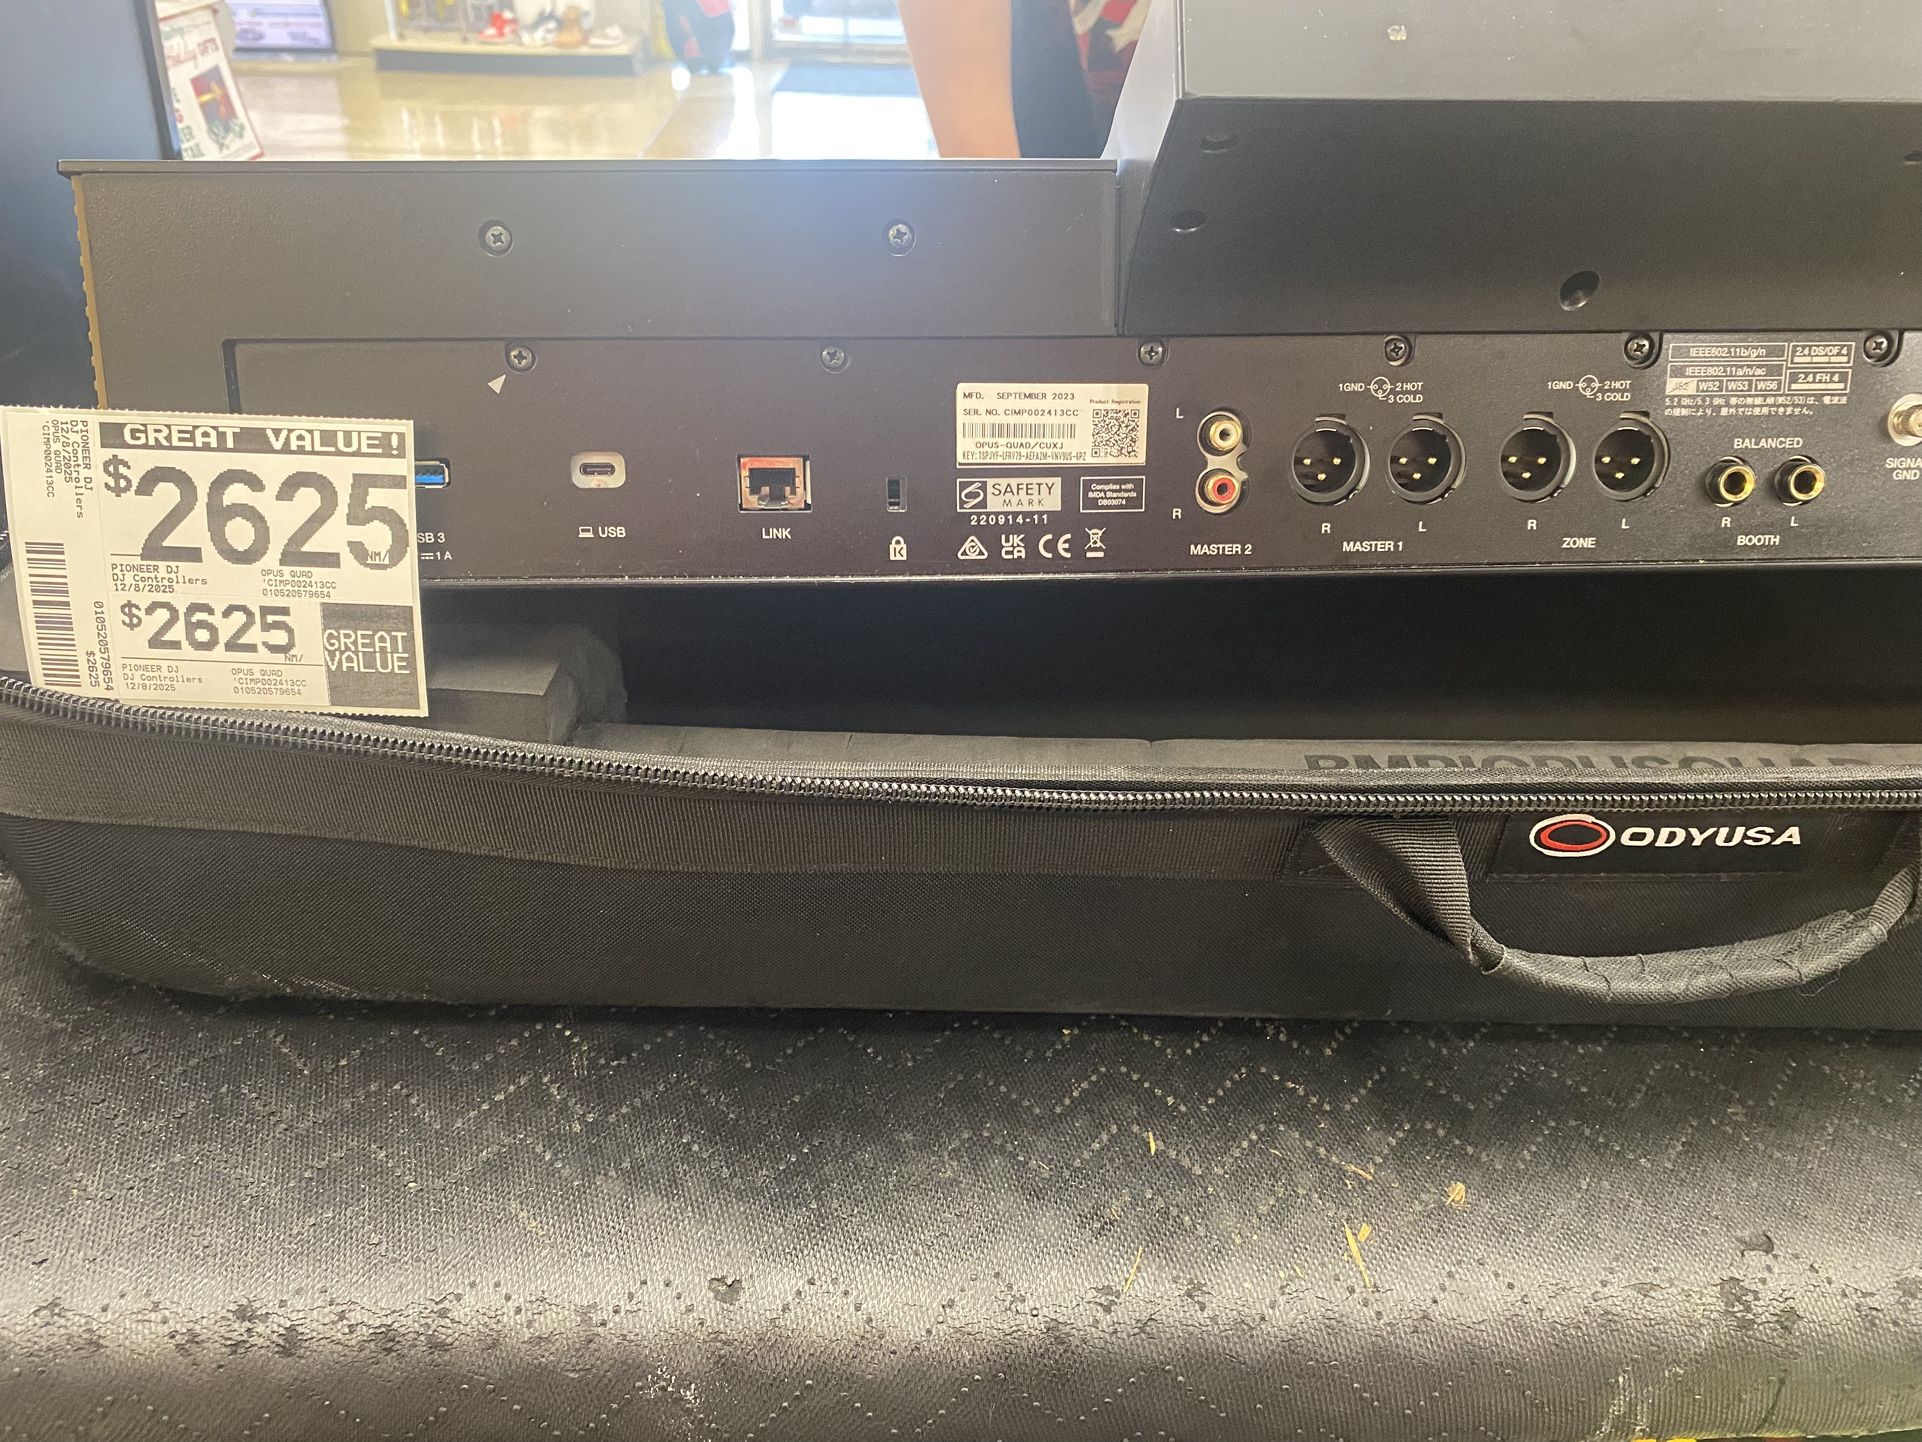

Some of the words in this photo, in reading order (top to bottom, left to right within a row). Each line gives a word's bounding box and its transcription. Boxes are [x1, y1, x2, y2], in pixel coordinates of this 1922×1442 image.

[1689, 347, 1767, 358] IEEE802.11b/g/n
[1795, 347, 1809, 356] 2.4
[1841, 347, 1848, 355] 4
[1685, 366, 1767, 377] IEEE802.11a/n/ac
[1798, 374, 1813, 383] 2.4
[1815, 374, 1831, 382] FH
[1832, 374, 1839, 382] 4
[1403, 383, 1424, 391] HOT
[1611, 381, 1632, 389] HOT
[1698, 381, 1720, 391] W52
[1727, 381, 1749, 391] W53
[1756, 381, 1778, 390] W56
[963, 392, 985, 400] MFD.
[996, 392, 1047, 400] SEPTEMBER
[1052, 392, 1075, 400] 2023
[1388, 394, 1394, 403] 3
[1396, 394, 1424, 403] COLD
[1596, 393, 1602, 401] 3
[1604, 392, 1631, 401] COLD
[963, 409, 982, 417] SER.
[985, 409, 1000, 417] NO.
[1004, 409, 1079, 417] CIMP002413CC
[1175, 407, 1184, 419] L
[51, 419, 61, 444] OPUS
[70, 420, 79, 434] DJ
[123, 423, 241, 448] GREAT
[265, 428, 400, 454] VALUE!
[1733, 438, 1803, 449] BALANCED
[80, 420, 91, 470] PIONEER
[975, 441, 1064, 449] OPUS-QUAD/CUXJ
[60, 420, 74, 484] 12/8/2025
[53, 449, 62, 475] QUAD
[1885, 457, 1922, 469] SIGNA
[71, 441, 84, 519] Controllers
[1892, 469, 1921, 480] GND
[84, 476, 93, 491] DJ
[1091, 483, 1120, 491] Complies
[991, 482, 1056, 497] SAFETY
[1002, 498, 1044, 507] MARK
[103, 454, 409, 570] $2625
[1172, 508, 1182, 519] R
[970, 514, 1048, 525] 220914-11
[1527, 519, 1537, 530] R
[1621, 518, 1630, 529] L
[1721, 517, 1731, 527] R
[1790, 516, 1799, 526] L
[598, 526, 626, 538] USB
[1321, 523, 1331, 533] R
[1418, 521, 1427, 532] L
[416, 532, 434, 543] SB
[437, 532, 446, 543] 3
[762, 528, 792, 539] LINK
[1561, 537, 1597, 548] ZONE
[1736, 535, 1780, 546] BOOTH
[1190, 544, 1242, 556] MASTER
[1244, 544, 1252, 555] 2
[1342, 541, 1394, 552] MASTER
[1396, 541, 1402, 552] 1
[444, 552, 453, 561] A
[111, 563, 160, 574] PIONEER
[166, 565, 179, 574] DJ
[261, 569, 286, 578] OPUS
[289, 570, 313, 579] QUAD
[112, 574, 126, 582] DJ
[133, 574, 208, 586] Controllers
[114, 583, 175, 594] 12/8/2025
[262, 588, 332, 599] 010520579654
[120, 600, 296, 655] $2625
[93, 600, 114, 691] 010520579654
[323, 629, 408, 652] GREAT
[324, 650, 411, 674] VALUE
[85, 650, 100, 688] $2625
[121, 664, 160, 674] PIONEER
[167, 665, 179, 674] DJ
[231, 668, 255, 676] OPUS
[260, 668, 283, 677] QUAD
[123, 673, 137, 681] DJ
[140, 673, 203, 684] Controllers
[125, 683, 176, 692] 12/8/2025
[233, 686, 302, 696] 010520579654
[1621, 825, 1802, 848] ODYUSA
